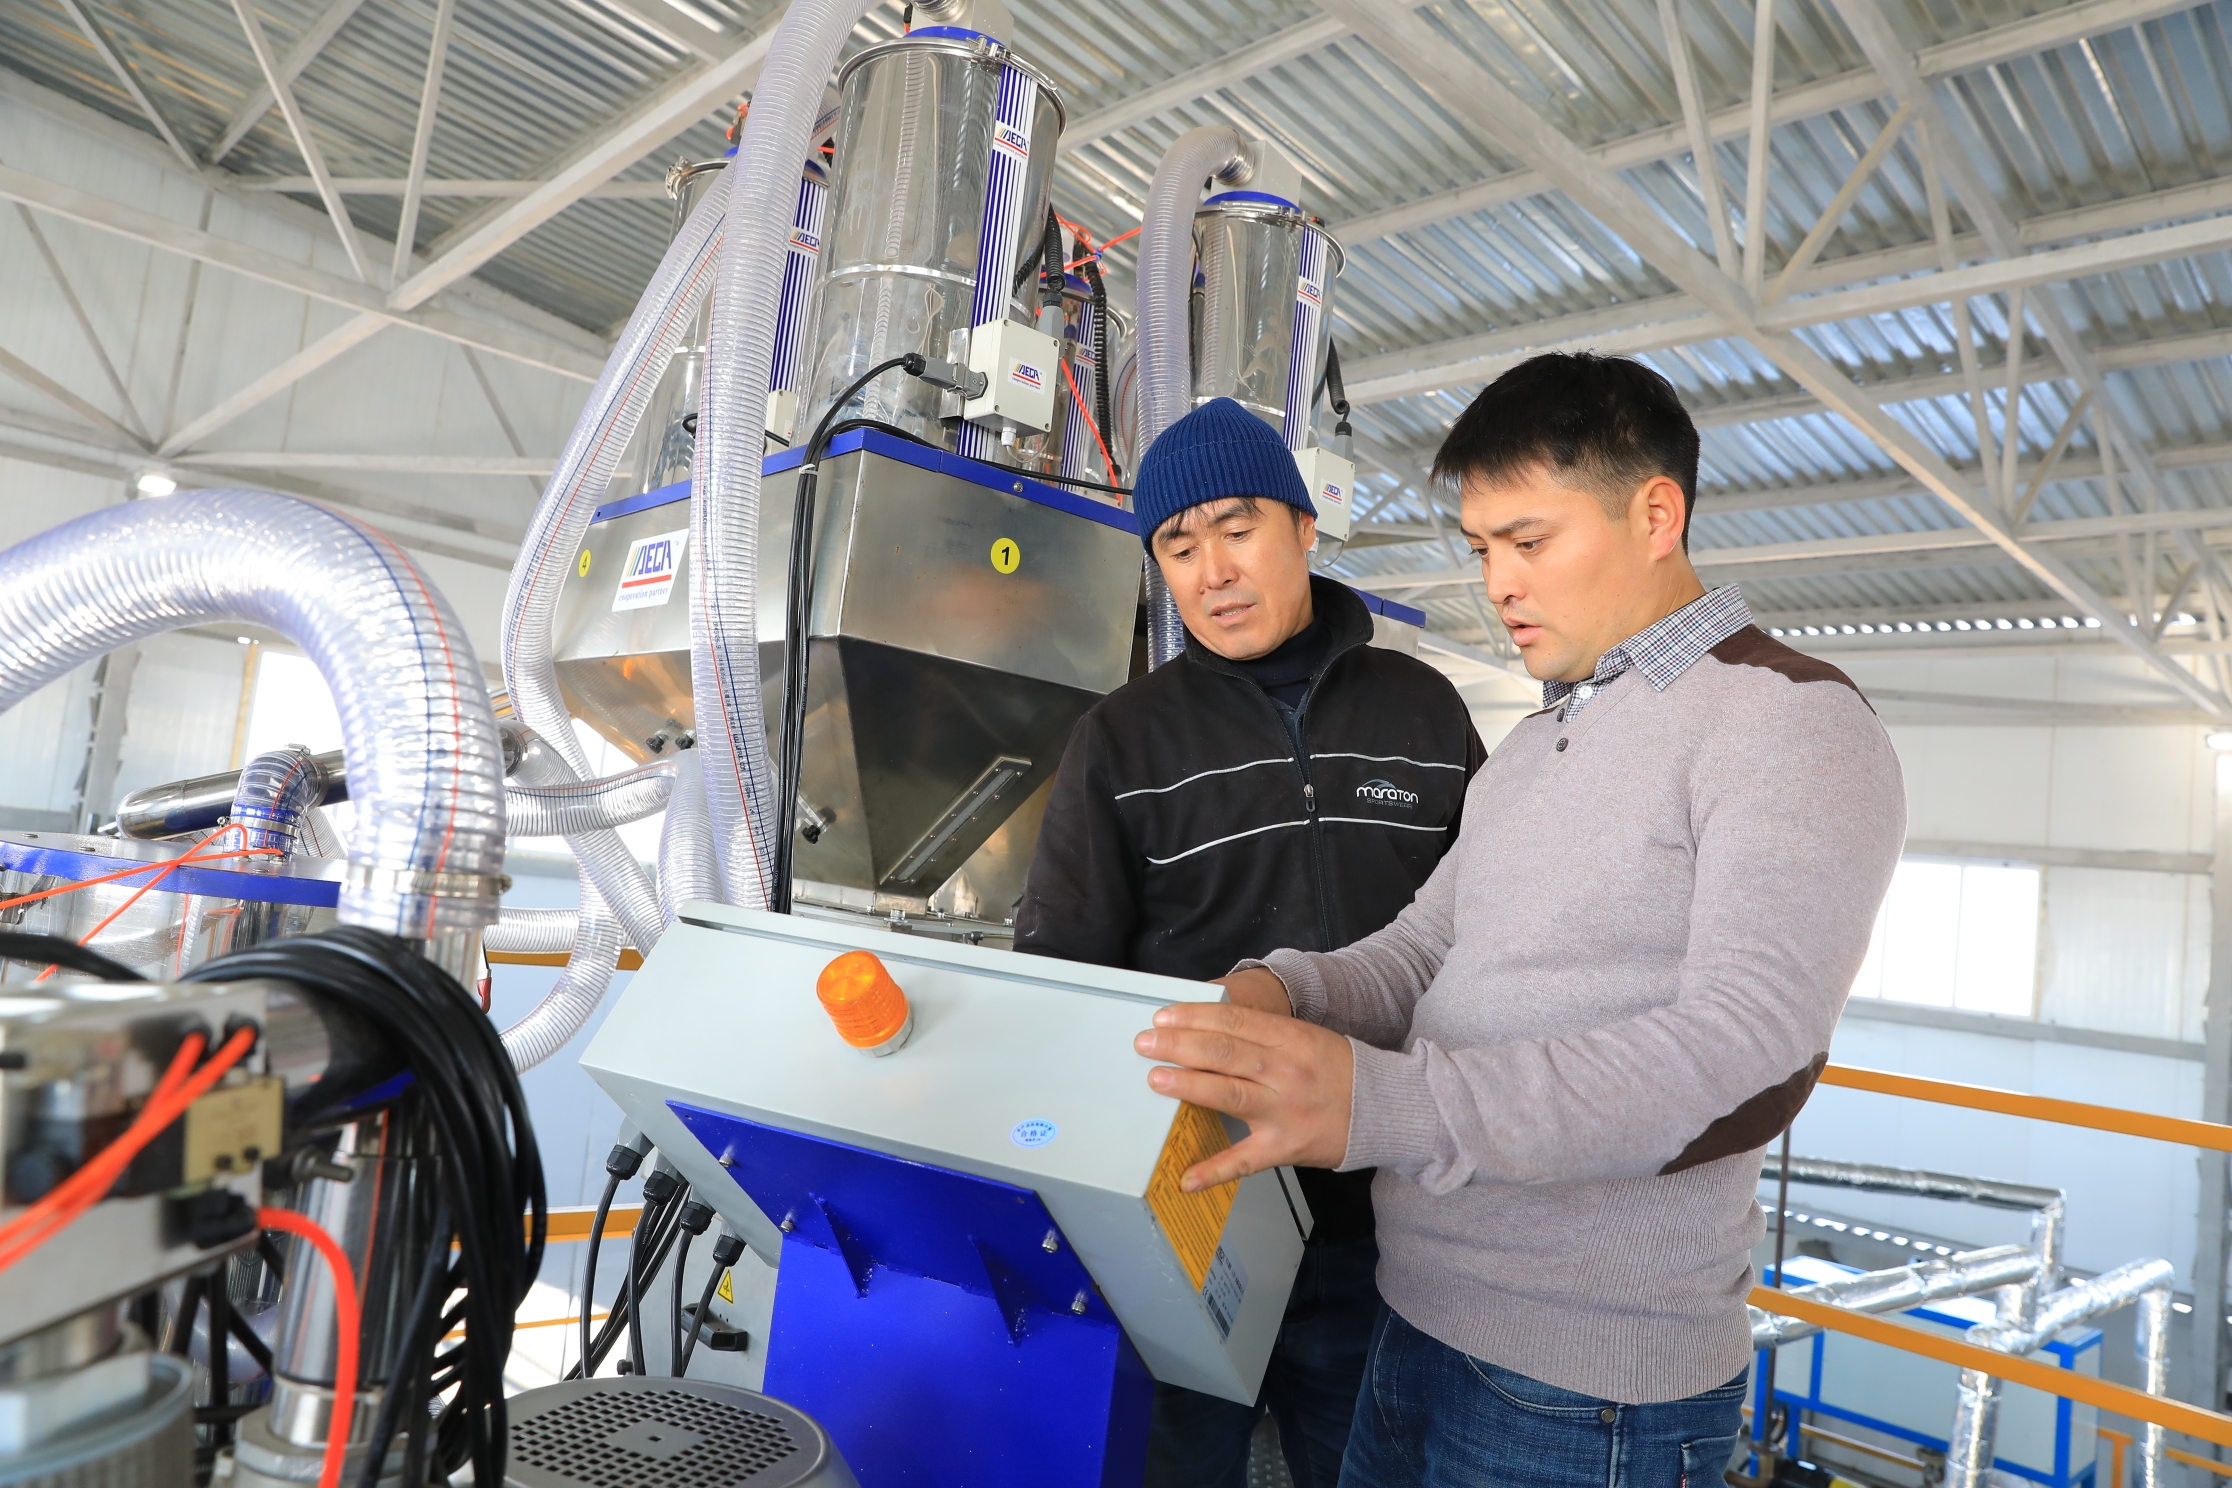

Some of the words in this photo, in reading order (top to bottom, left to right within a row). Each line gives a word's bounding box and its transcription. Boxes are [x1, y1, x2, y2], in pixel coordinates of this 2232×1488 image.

[581, 555, 588, 571] 4
[1001, 546, 1010, 566] 1
[618, 589, 649, 602] cooperation
[648, 587, 669, 600] partner
[1366, 797, 1413, 810] SPORTSWEAR
